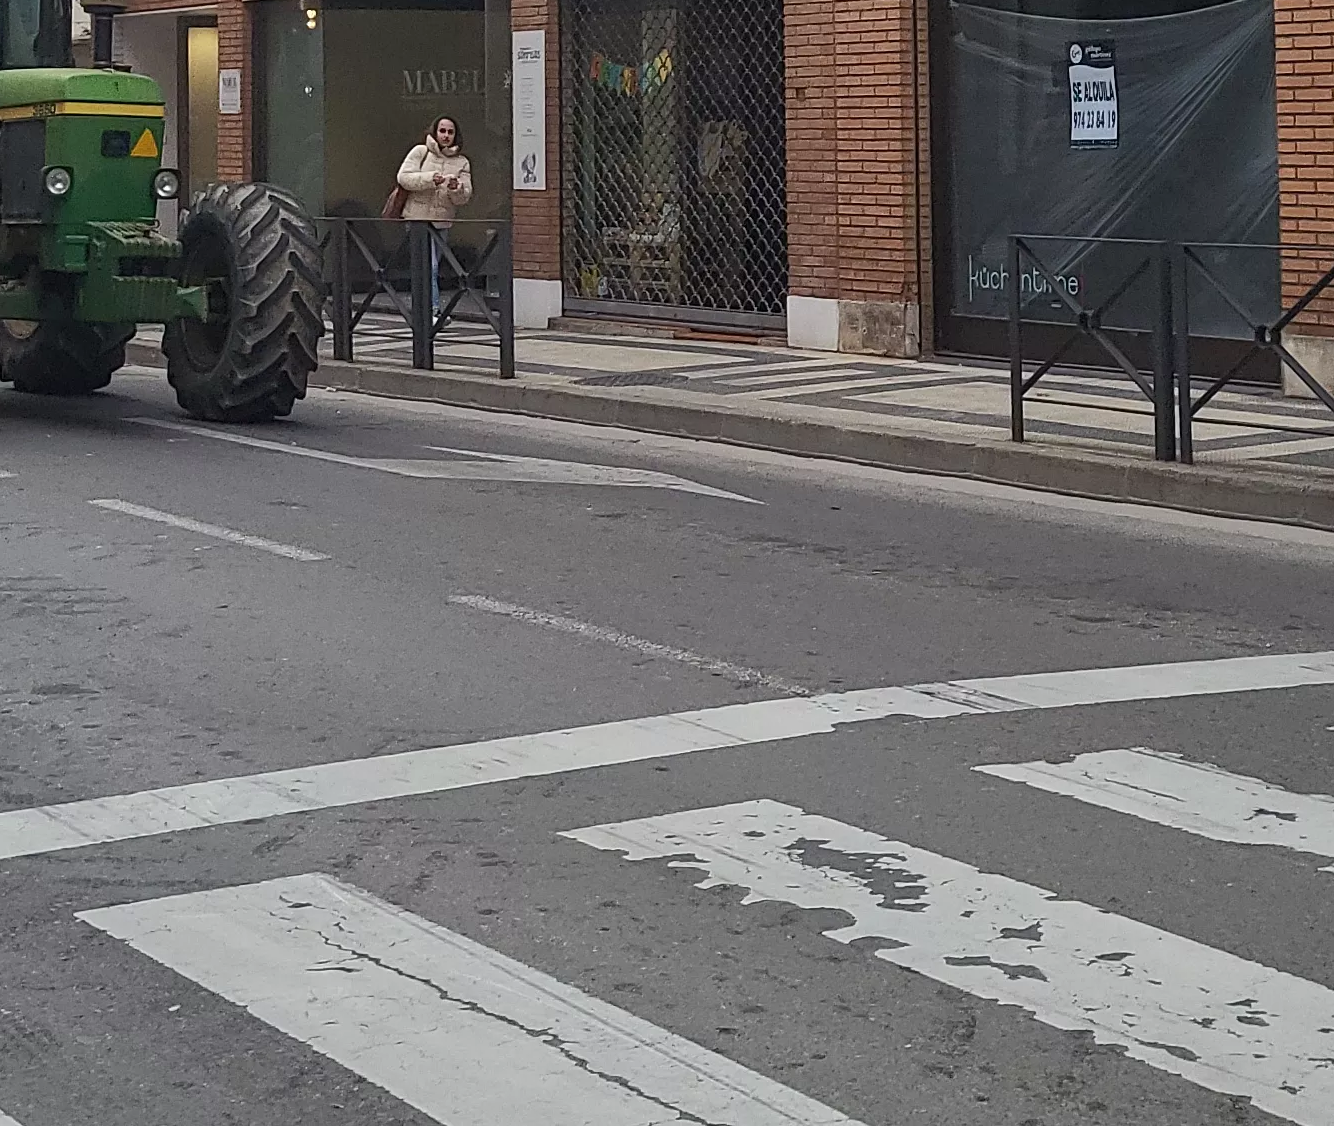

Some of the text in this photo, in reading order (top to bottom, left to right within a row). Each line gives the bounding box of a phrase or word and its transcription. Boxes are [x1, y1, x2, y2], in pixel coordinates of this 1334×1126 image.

[1072, 79, 1115, 103] SE ALQUILA
[1073, 110, 1085, 129] 974
[1096, 110, 1105, 129] 84
[1107, 110, 1116, 129] 19
[968, 254, 1079, 303] küchntime
